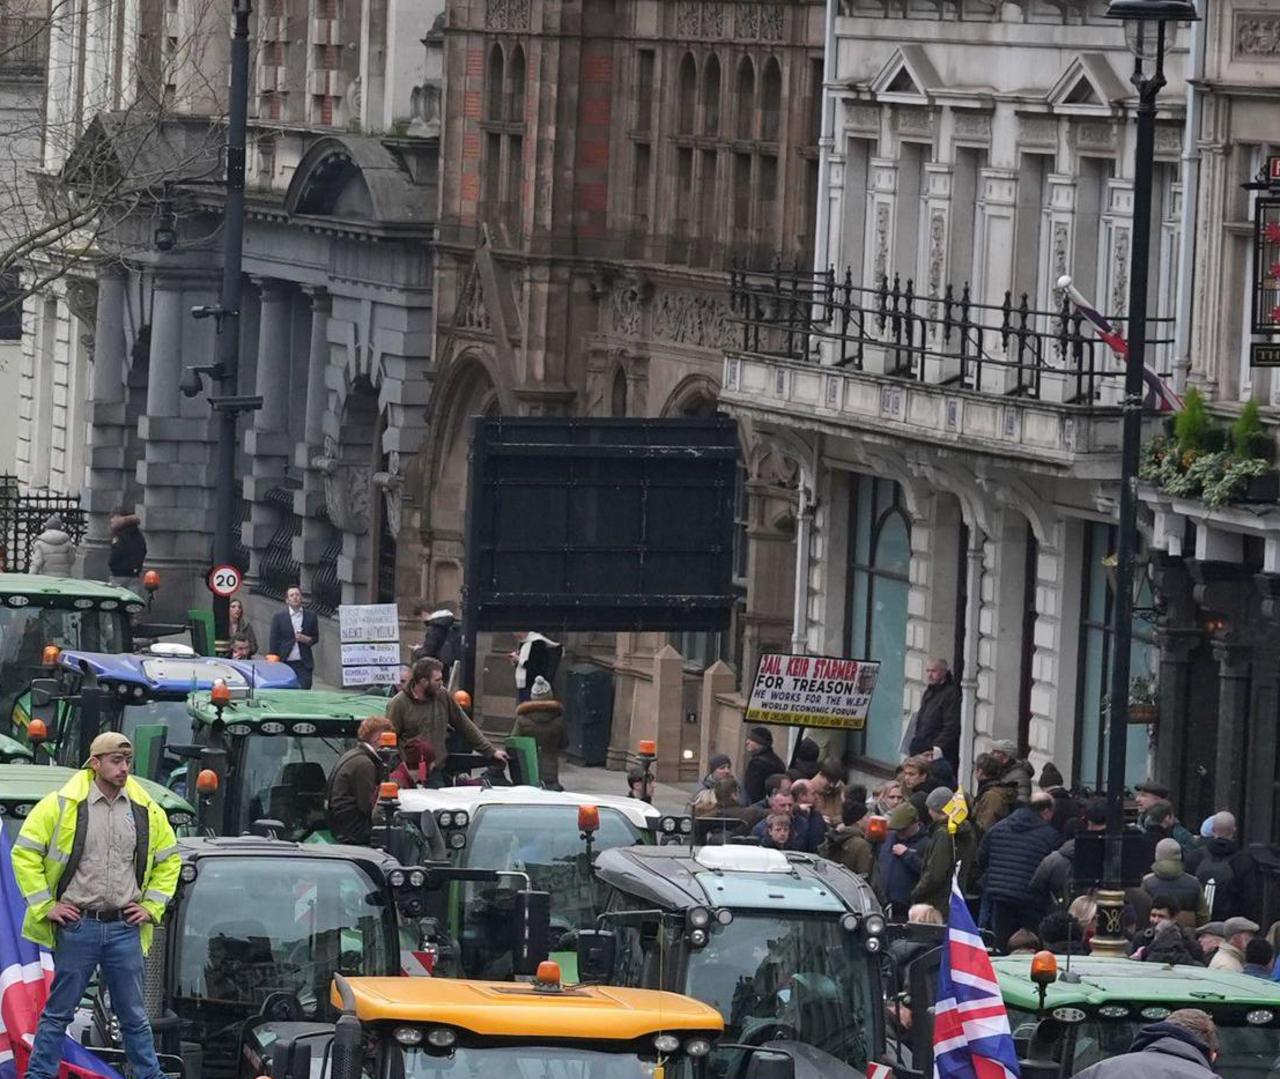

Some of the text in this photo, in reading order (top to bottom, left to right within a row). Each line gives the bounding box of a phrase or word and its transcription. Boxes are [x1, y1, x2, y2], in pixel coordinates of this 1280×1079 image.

[215, 574, 237, 588] 20
[760, 655, 858, 682] JAIL KEIR STARMER
[756, 675, 854, 695] FOR TREASON
[753, 689, 766, 699] HE
[770, 690, 801, 702] WORKS
[805, 694, 822, 705] FOR
[826, 695, 842, 706] THE
[761, 701, 858, 716] WORLD ECONOMIC FORUM
